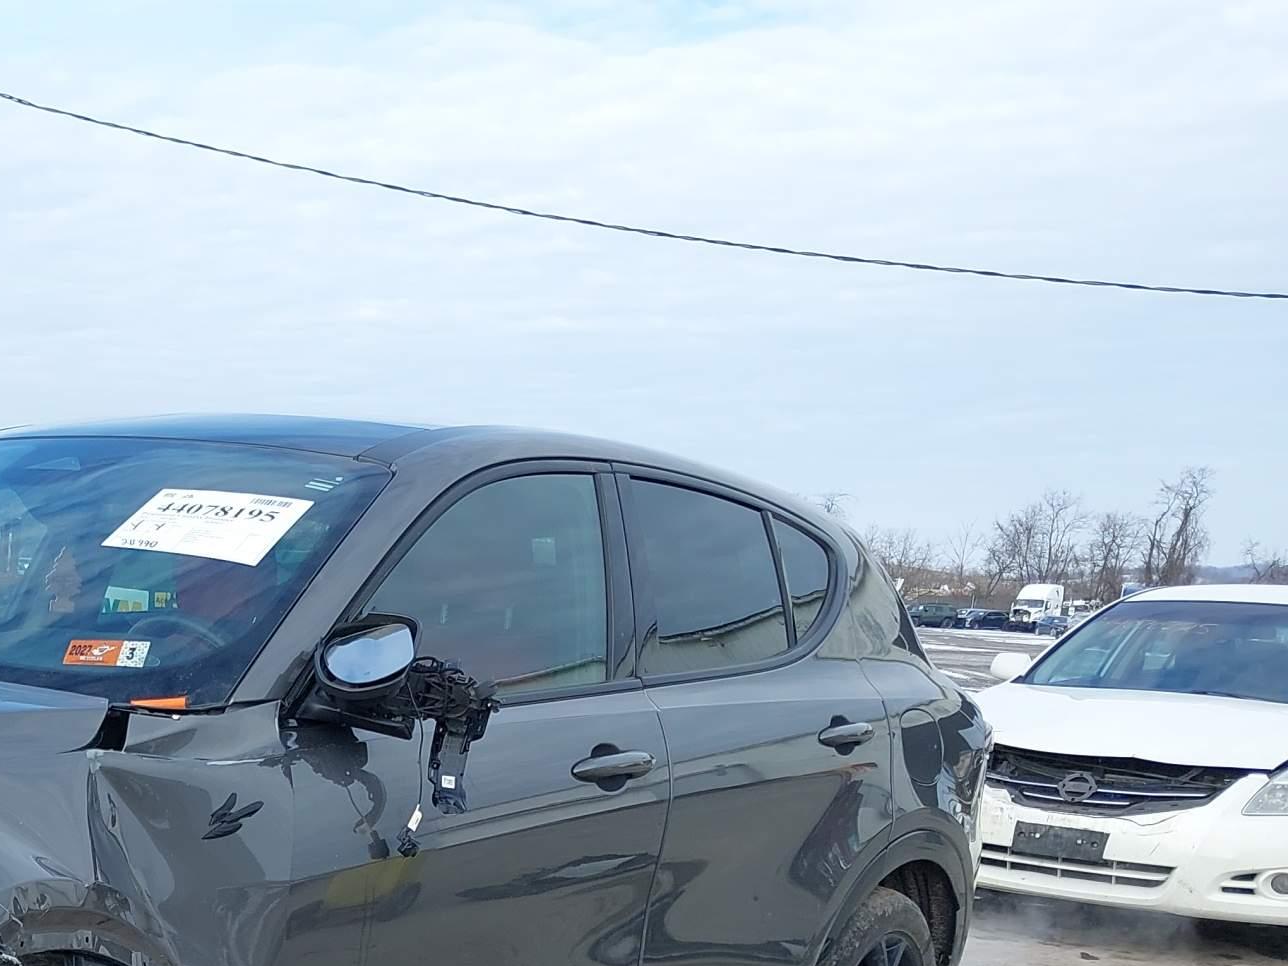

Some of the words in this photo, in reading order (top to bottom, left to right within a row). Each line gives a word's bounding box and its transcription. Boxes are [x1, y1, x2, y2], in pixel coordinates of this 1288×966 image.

[157, 502, 279, 522] 44078195
[69, 644, 93, 656] 2027
[126, 648, 137, 660] 3
